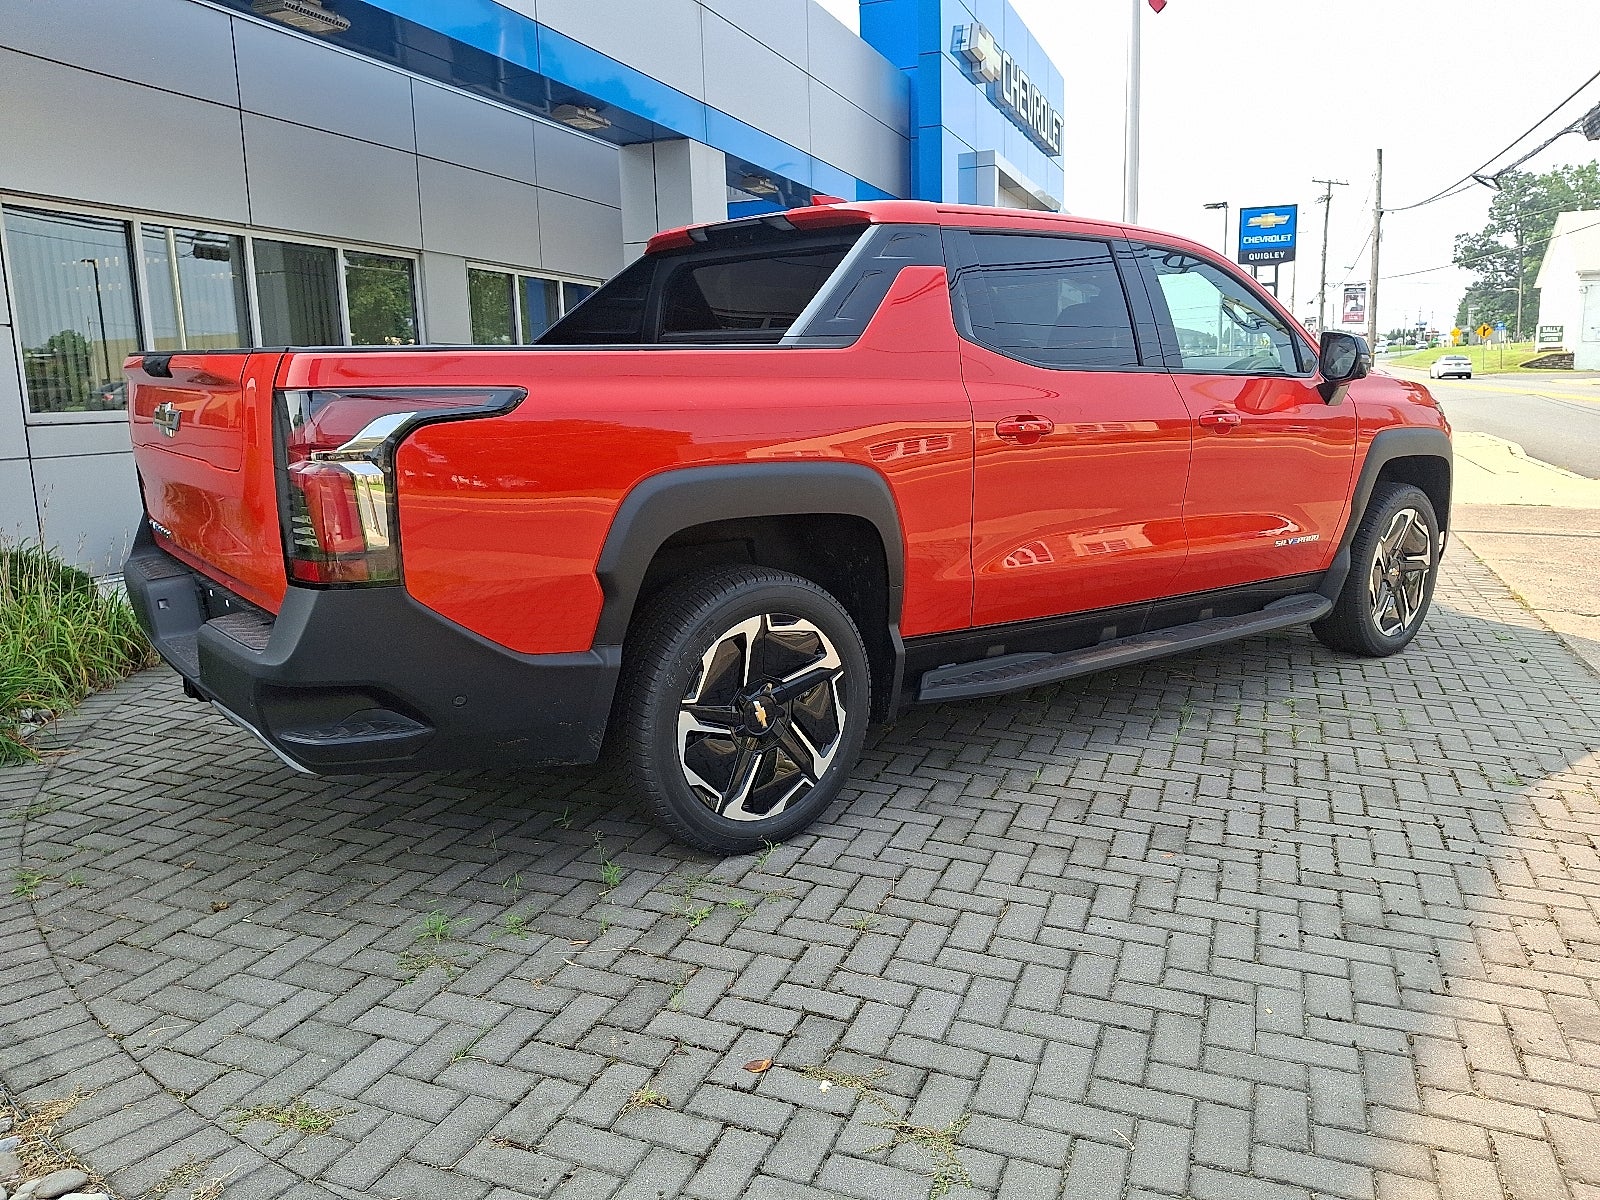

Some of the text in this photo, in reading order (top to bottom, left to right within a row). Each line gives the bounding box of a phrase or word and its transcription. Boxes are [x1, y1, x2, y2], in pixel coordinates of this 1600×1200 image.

[1001, 49, 1064, 156] CHEVROLET
[1243, 234, 1292, 244] CHEVROLET
[1248, 250, 1285, 261] QUIGLEY
